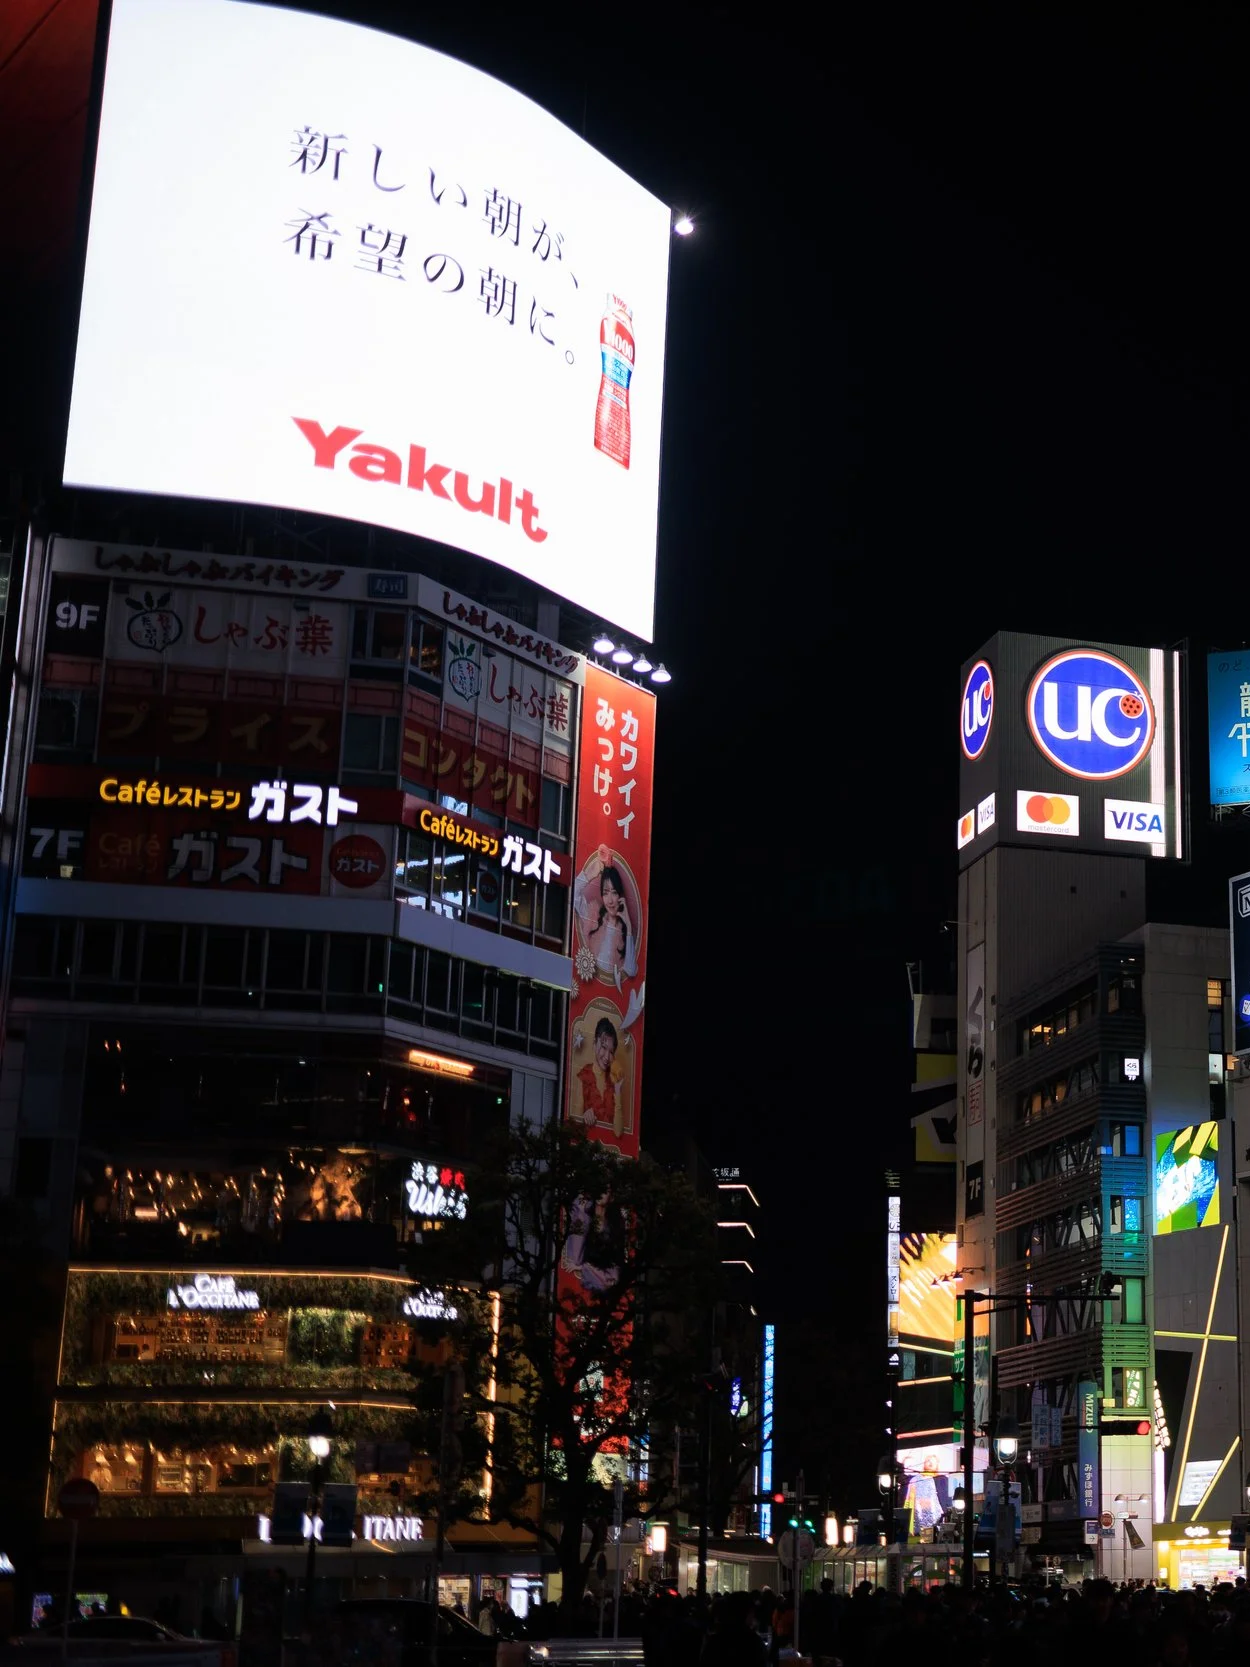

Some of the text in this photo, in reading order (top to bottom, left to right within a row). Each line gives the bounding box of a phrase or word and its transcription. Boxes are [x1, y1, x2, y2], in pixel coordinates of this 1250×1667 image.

[288, 125, 579, 290] 新しい朝が、
[281, 206, 576, 366] 希望の朝に。
[290, 416, 548, 543] Yakult
[56, 602, 100, 629] 9F
[194, 606, 333, 656] しゃぶ葉
[489, 663, 569, 732] しゃぶ葉
[105, 700, 328, 753] プライス
[402, 727, 536, 811] コンタクト
[594, 697, 615, 816] みつけ。
[617, 710, 639, 840] カワイイ
[248, 780, 358, 825] ガスト
[1107, 810, 1162, 833] VISA
[28, 828, 85, 860] 7F
[1028, 824, 1070, 834] mastercard
[167, 830, 310, 885] ガスト
[336, 857, 380, 873] ガスト
[501, 836, 561, 884] ガスト
[969, 1177, 982, 1200] 7F
[1084, 1463, 1093, 1507] みずほ銀行
